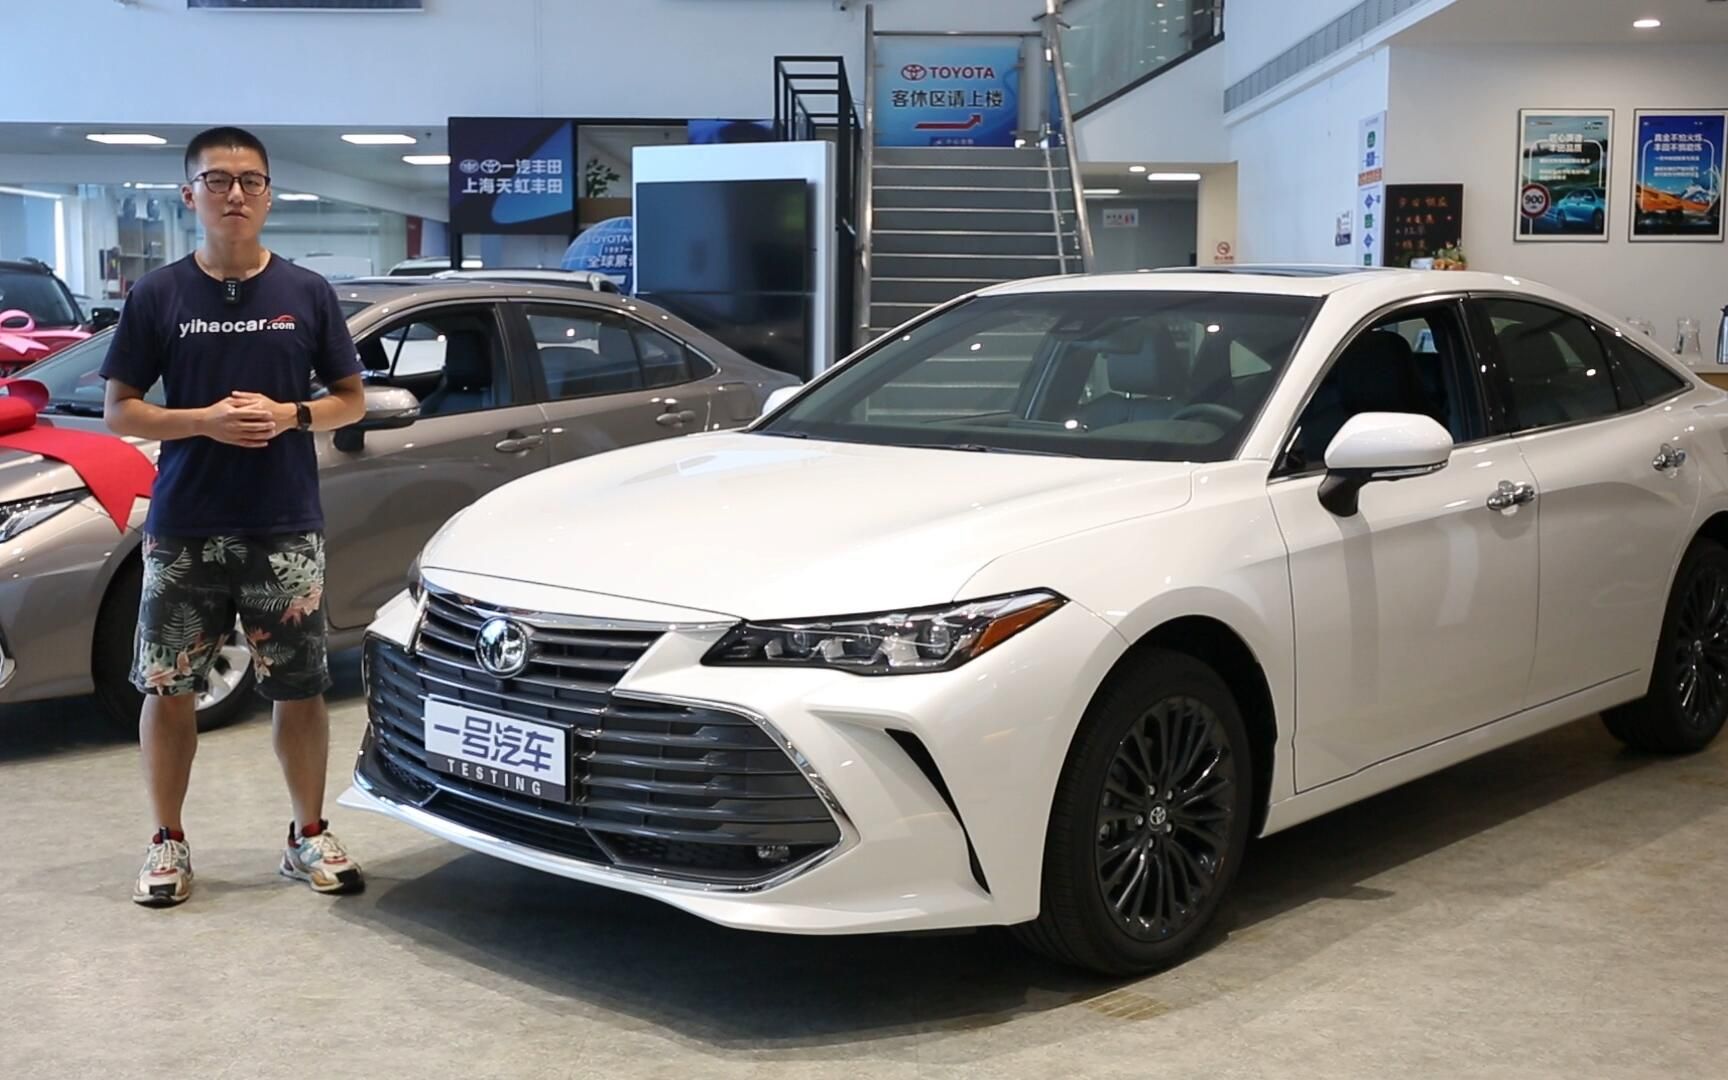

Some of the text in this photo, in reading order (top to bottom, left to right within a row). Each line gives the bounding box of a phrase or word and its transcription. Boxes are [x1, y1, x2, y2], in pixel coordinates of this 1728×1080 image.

[928, 67, 995, 79] TOYOTA
[891, 90, 1003, 108] 客休区请上楼
[501, 159, 562, 174] 一汽丰田
[462, 178, 563, 194] 上海天虹丰田
[1525, 194, 1544, 205] 900
[178, 318, 295, 339] yihaocar.com
[433, 714, 554, 772] 一号汽车
[447, 758, 542, 796] TESTING
